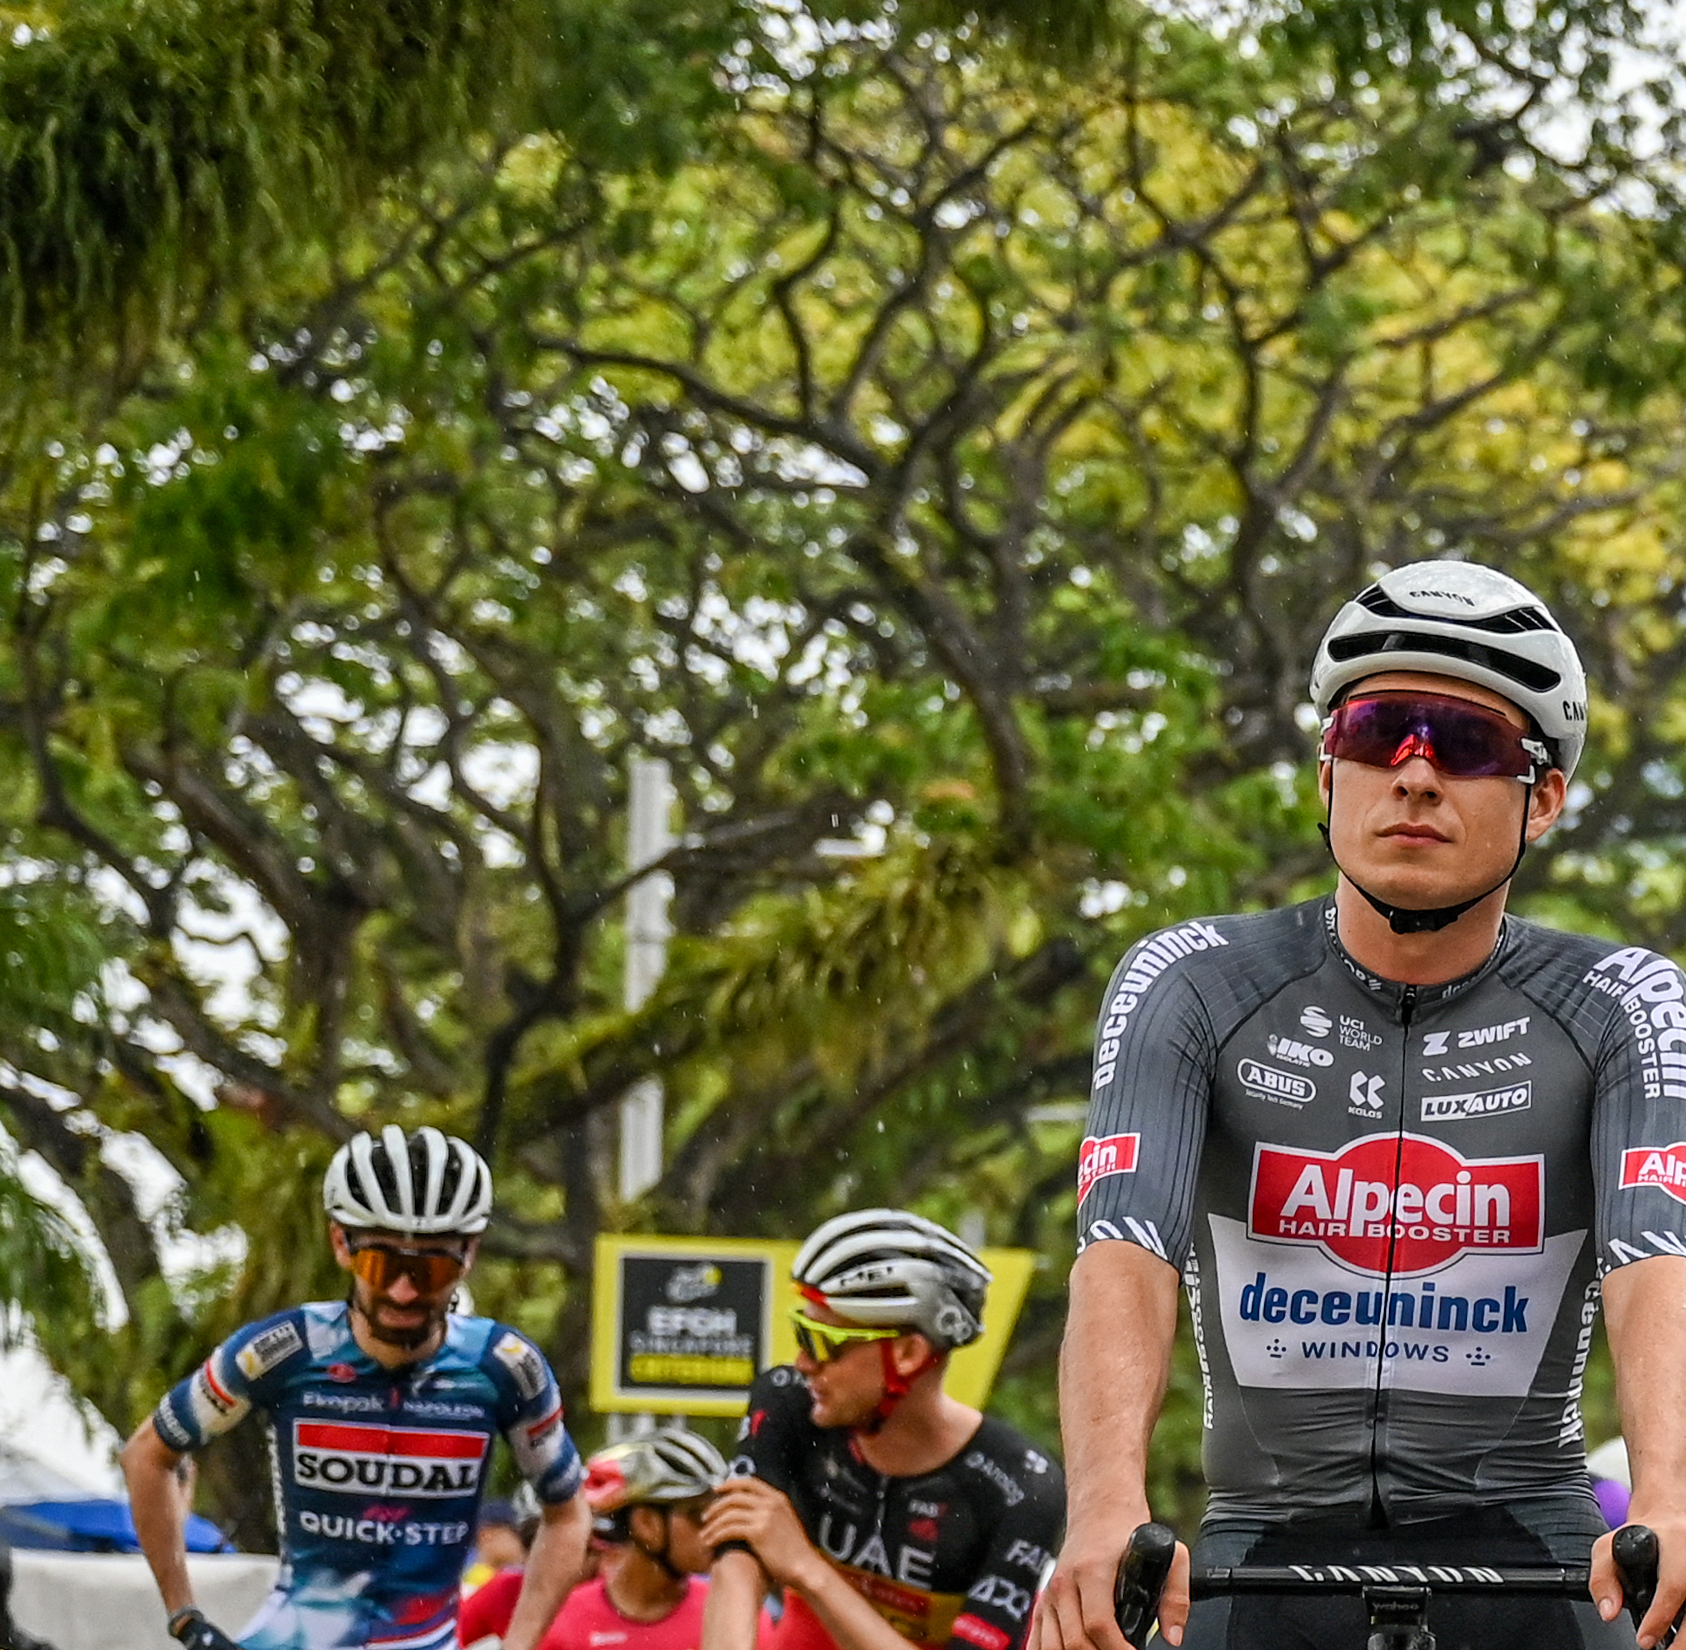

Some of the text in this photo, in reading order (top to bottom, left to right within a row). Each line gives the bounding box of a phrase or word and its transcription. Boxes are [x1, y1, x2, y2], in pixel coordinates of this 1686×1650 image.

[1409, 589, 1475, 607] CANYON
[1094, 921, 1229, 1090] deceuninck
[1338, 1024, 1383, 1045] WORLD
[1339, 1014, 1364, 1030] UCI
[1457, 1017, 1531, 1049] ZWIFT
[1277, 1037, 1335, 1067] IKO
[1338, 1036, 1371, 1051] TEAM
[1623, 998, 1661, 1100] BOOSTER
[1247, 1066, 1307, 1097] ABUS
[1422, 1051, 1532, 1083] CANYON
[1424, 1087, 1527, 1117] LUXAUTO
[1280, 1163, 1511, 1238] Alpecin
[1278, 1218, 1510, 1244] HAIR BOOSTER
[1239, 1272, 1530, 1333] deceuninck
[1301, 1340, 1449, 1362] WINDOWS
[297, 1453, 478, 1491] SOUDAL
[1289, 1565, 1504, 1583] CANYON
